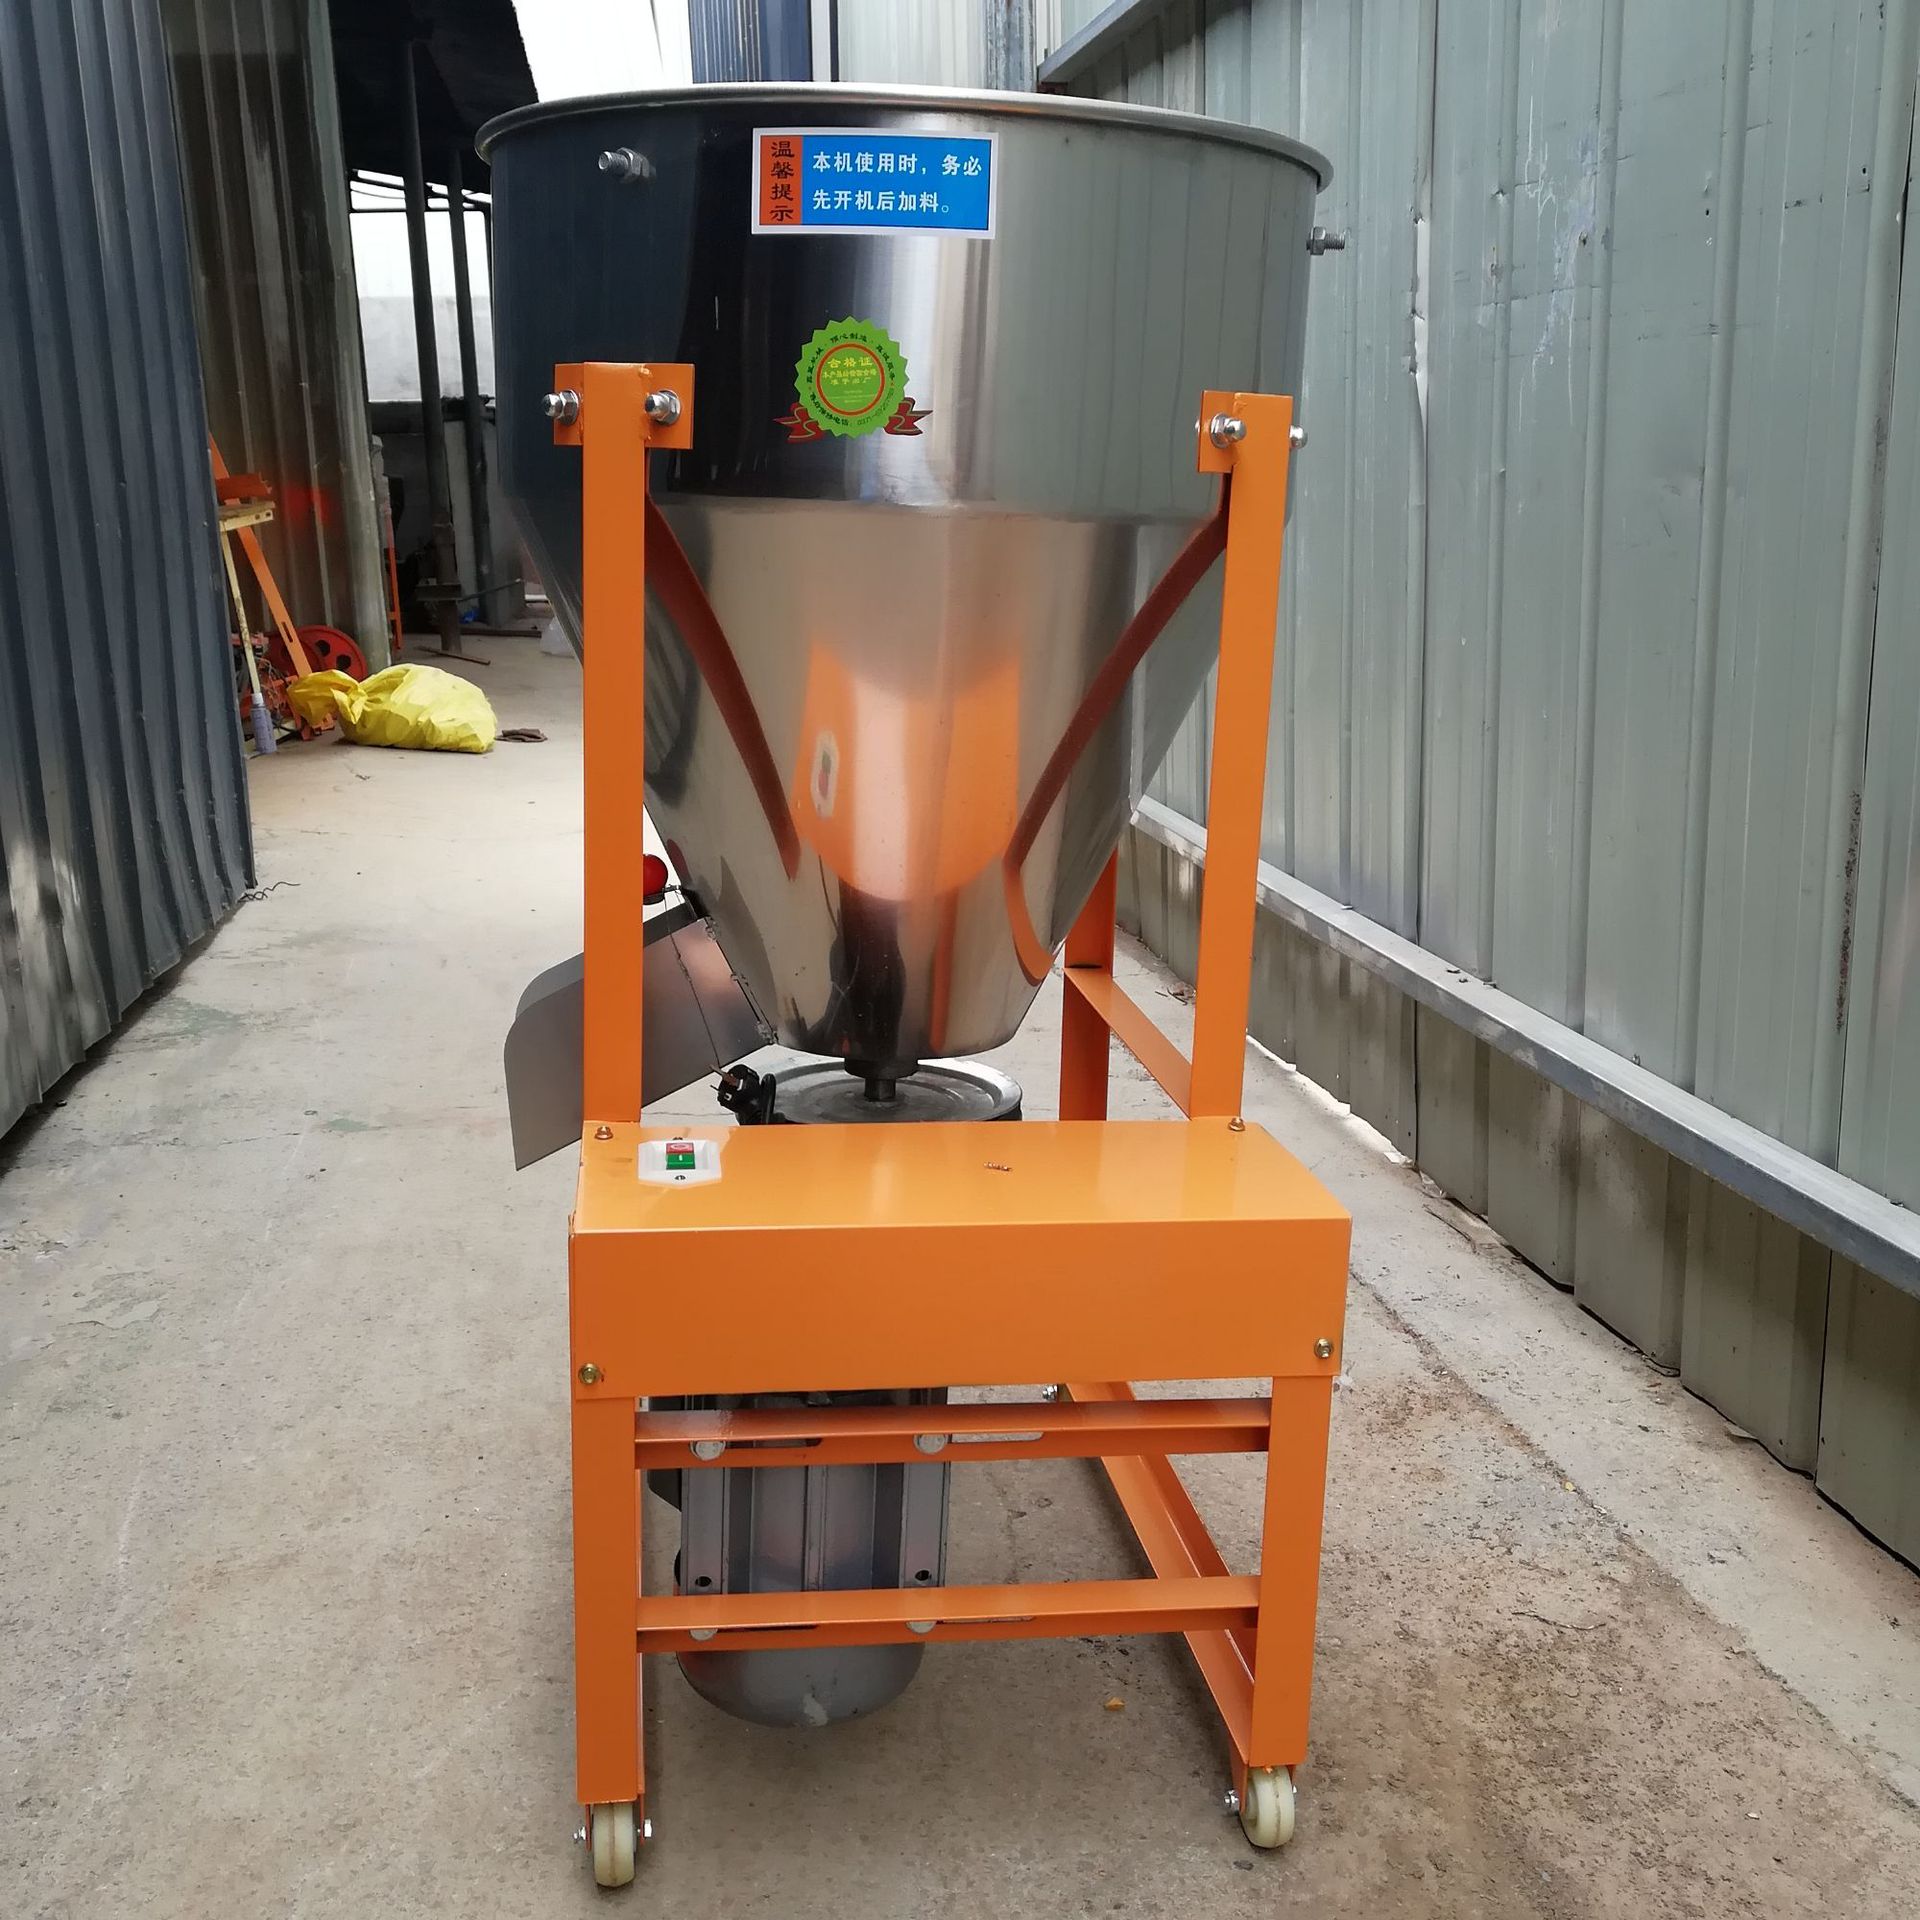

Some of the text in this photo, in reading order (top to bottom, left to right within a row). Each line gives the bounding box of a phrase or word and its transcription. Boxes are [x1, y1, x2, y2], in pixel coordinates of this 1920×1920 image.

[812, 151, 982, 176] 本机使用时，务必
[769, 140, 795, 222] 温馨提示
[812, 188, 950, 213] 先开机后加料。
[827, 356, 873, 369] 合格证
